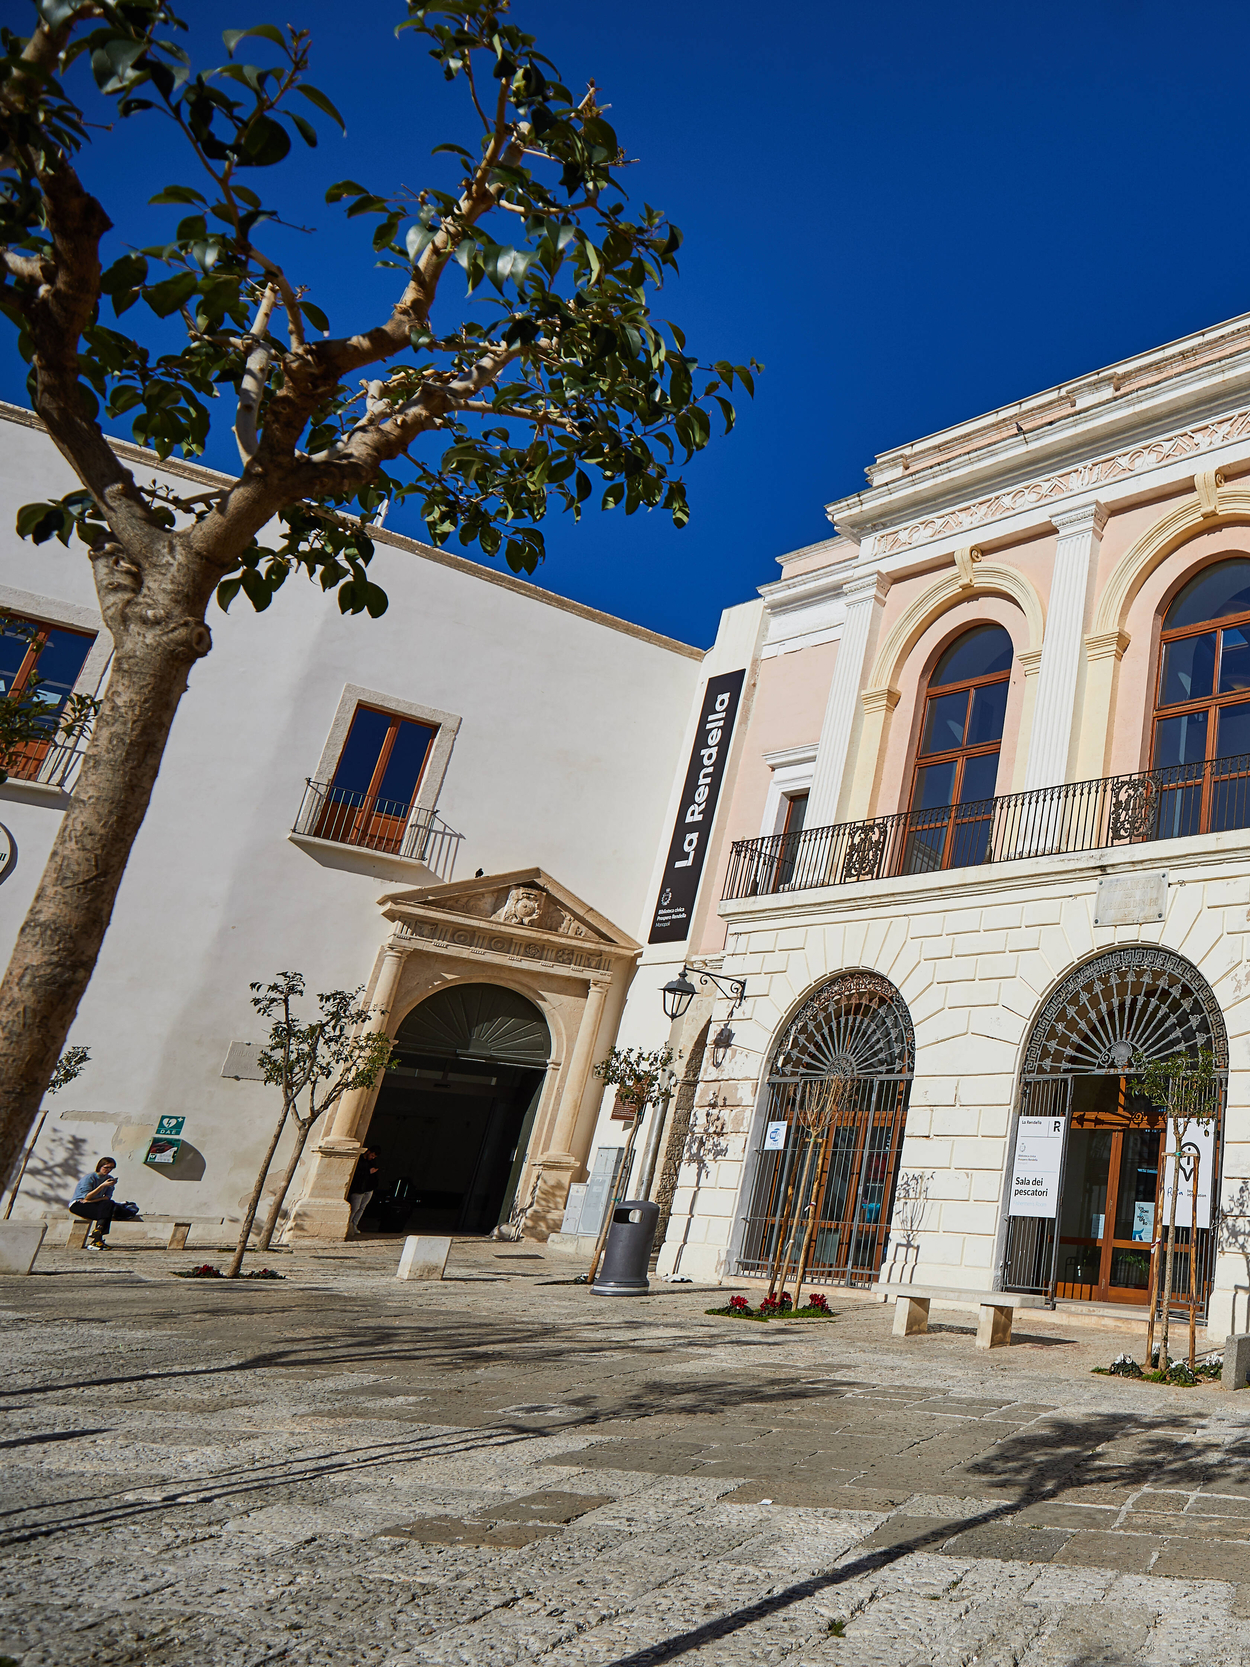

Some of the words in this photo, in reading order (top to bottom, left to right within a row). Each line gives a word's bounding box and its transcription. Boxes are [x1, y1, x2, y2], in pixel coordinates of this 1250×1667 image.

[685, 692, 730, 823] Rendella
[674, 832, 699, 868] La
[1053, 1121, 1061, 1132] R
[1015, 1176, 1030, 1185] Sala
[1031, 1177, 1043, 1186] dei
[1014, 1188, 1048, 1196] pescatori
